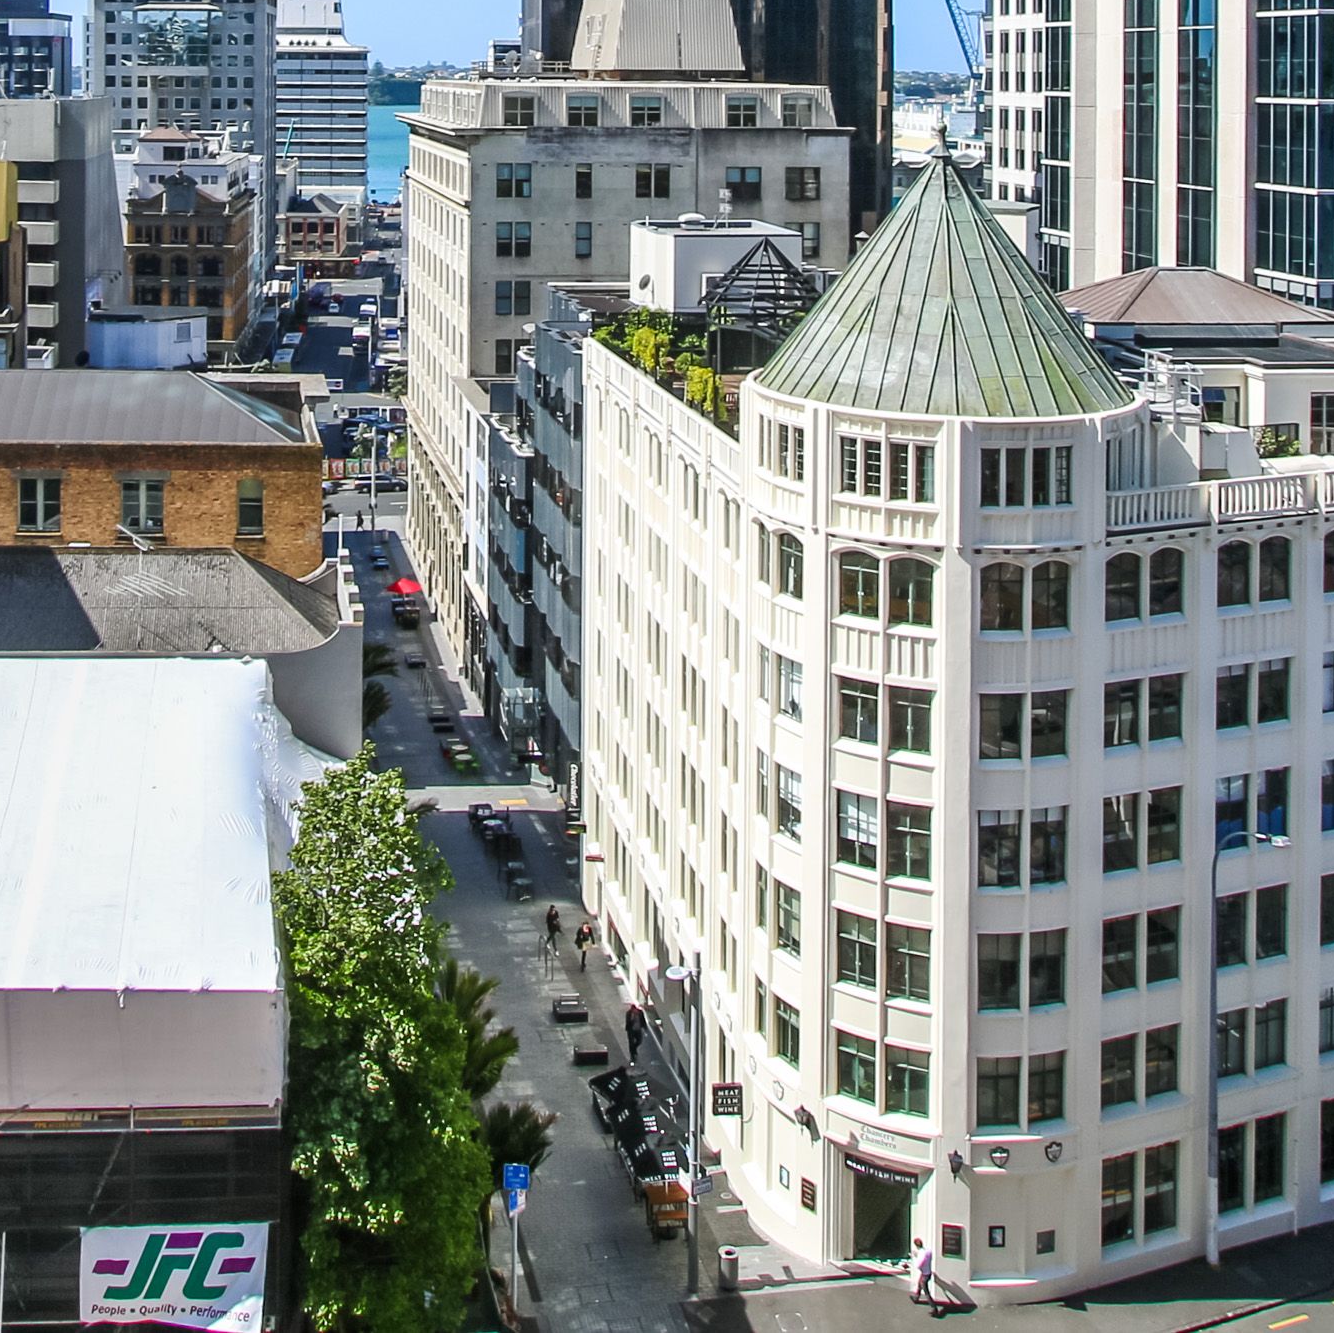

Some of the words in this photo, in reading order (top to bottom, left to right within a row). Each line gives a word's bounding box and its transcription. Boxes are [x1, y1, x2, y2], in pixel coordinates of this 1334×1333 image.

[894, 1174, 916, 1184] WINE
[101, 1232, 247, 1300] JFC
[91, 1304, 126, 1315] People
[139, 1304, 178, 1316] Quality
